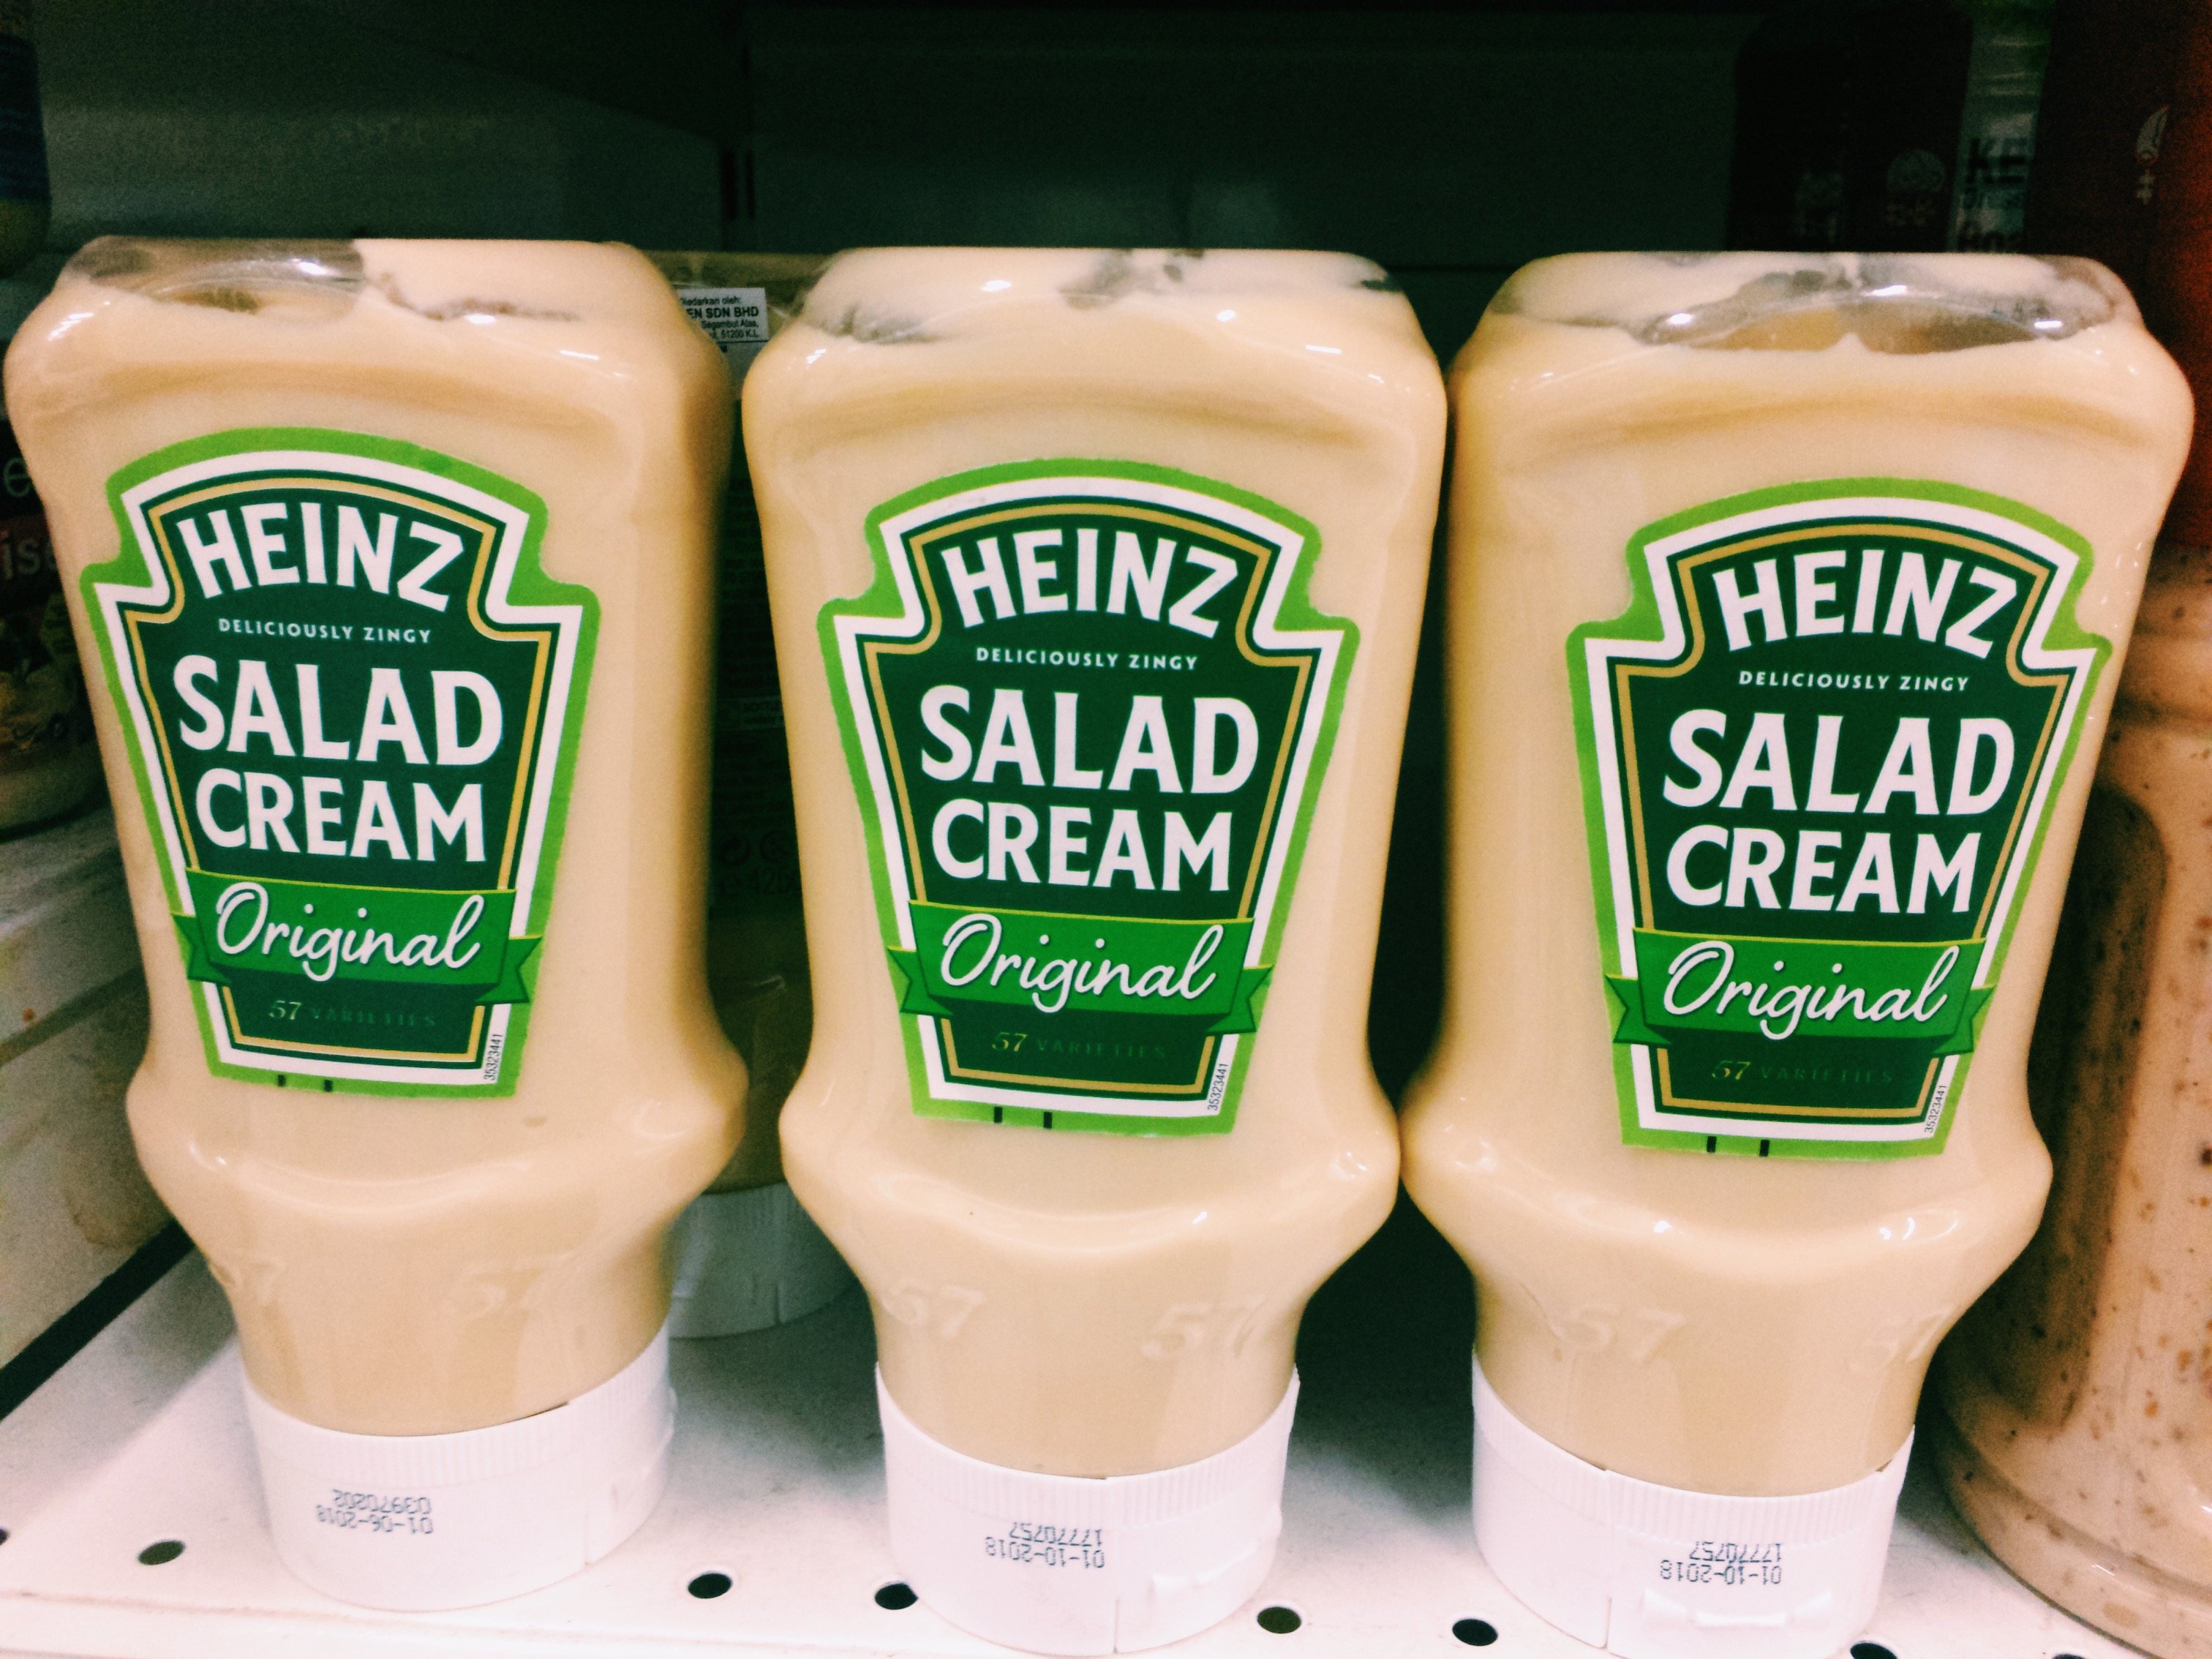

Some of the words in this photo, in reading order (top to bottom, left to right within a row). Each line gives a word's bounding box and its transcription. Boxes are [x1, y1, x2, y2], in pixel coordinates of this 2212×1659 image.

[706, 307, 730, 318] SDN
[734, 306, 759, 317] BHD
[176, 502, 464, 612] HEINZ
[941, 528, 1238, 639] HEINZ
[1712, 549, 2017, 659] HEINZ
[219, 618, 353, 640] DELICIOUSLY
[364, 627, 432, 644] ZINGY
[977, 647, 1119, 668] DELICIOUSLY
[1129, 653, 1198, 672] ZINGY
[1739, 671, 1889, 691] DELICIOUSLY
[1899, 674, 1969, 692] ZINGY
[173, 655, 503, 765] SALAD
[919, 685, 1260, 794] SALAD
[1662, 709, 2016, 816] SALAD
[195, 767, 487, 862] CREAM
[932, 799, 1232, 892] CREAM
[1666, 824, 1982, 914] CREAM
[215, 882, 485, 982] Original
[941, 913, 1224, 1013] Original
[268, 1000, 302, 1020] 57
[1663, 940, 1960, 1040] Original
[484, 1034, 503, 1080] 35323441
[991, 1031, 1028, 1053] 57
[1208, 1063, 1229, 1110] 35323441
[1711, 1060, 1751, 1080] 57
[1925, 1085, 1947, 1133] 35323441
[333, 1489, 432, 1515] 03970202
[985, 1537, 1105, 1568] 01-10-2018
[1009, 1521, 1102, 1547] 17770757
[1690, 1541, 1781, 1562] 17770757
[1660, 1560, 1782, 1584] 01-10-2018
